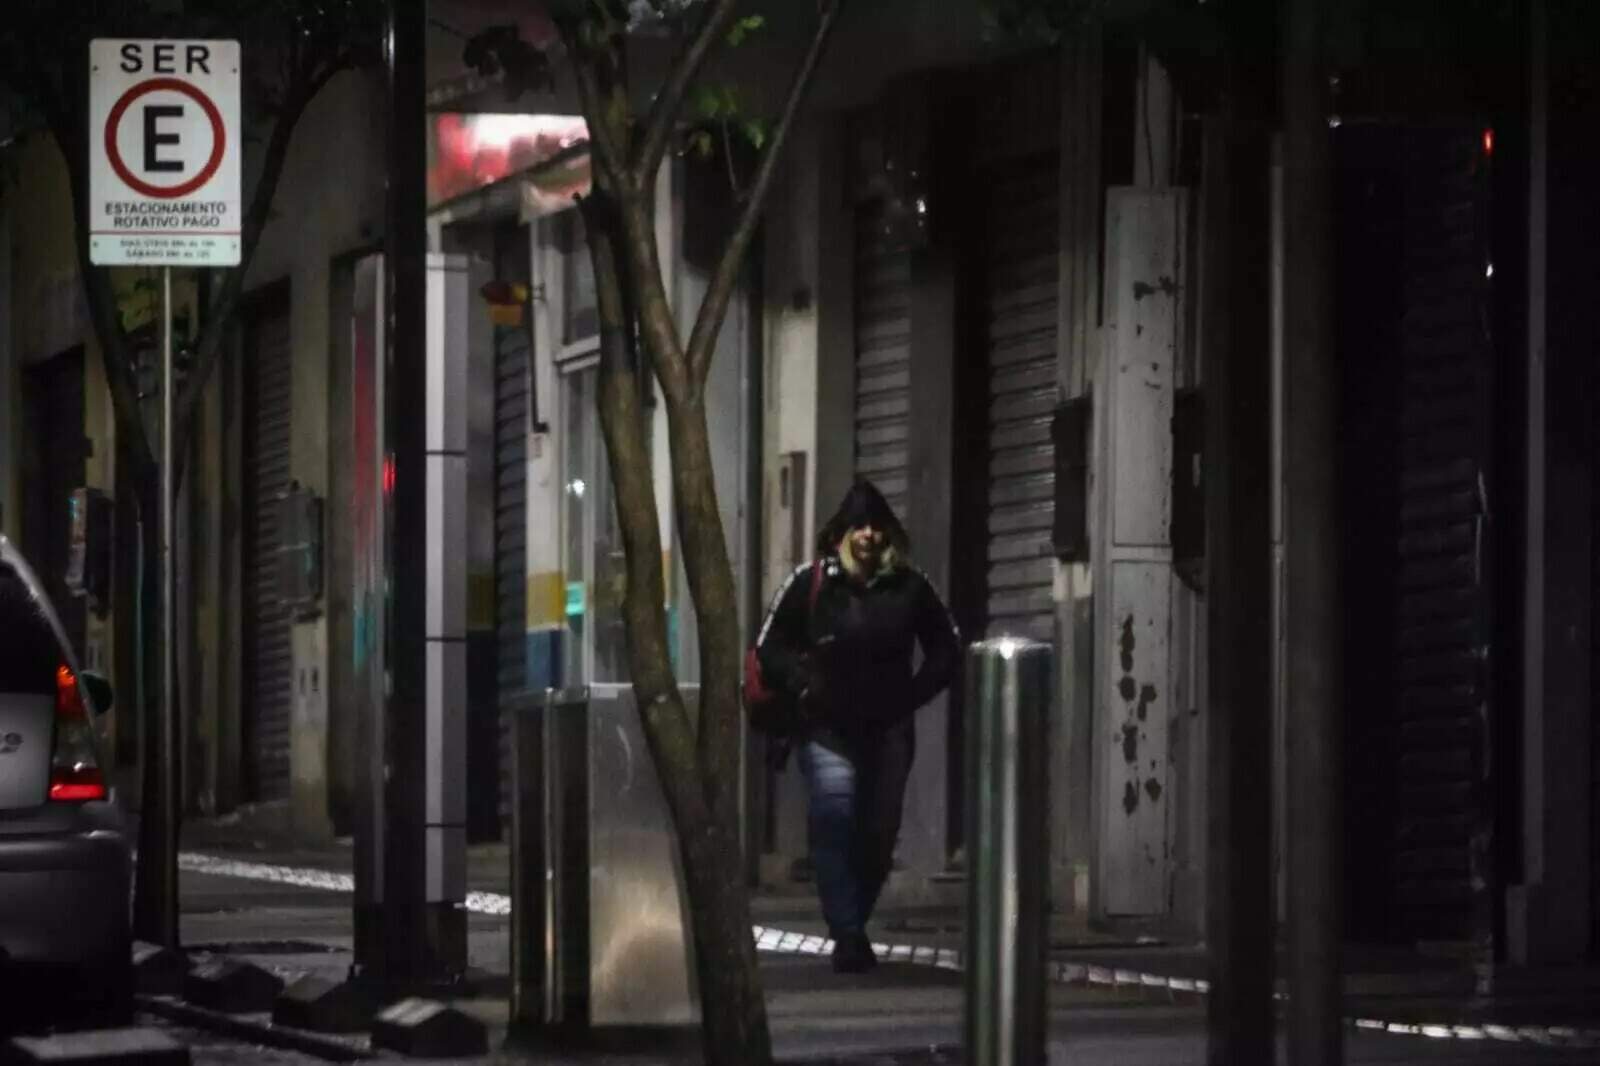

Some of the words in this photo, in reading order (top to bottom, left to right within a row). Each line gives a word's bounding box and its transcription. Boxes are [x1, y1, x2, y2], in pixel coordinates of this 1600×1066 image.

[120, 43, 211, 74] SER
[143, 105, 185, 172] E
[104, 202, 227, 215] ESTACIONAMENTO
[113, 216, 179, 228] ROTATIVO
[181, 215, 221, 228] PAGO
